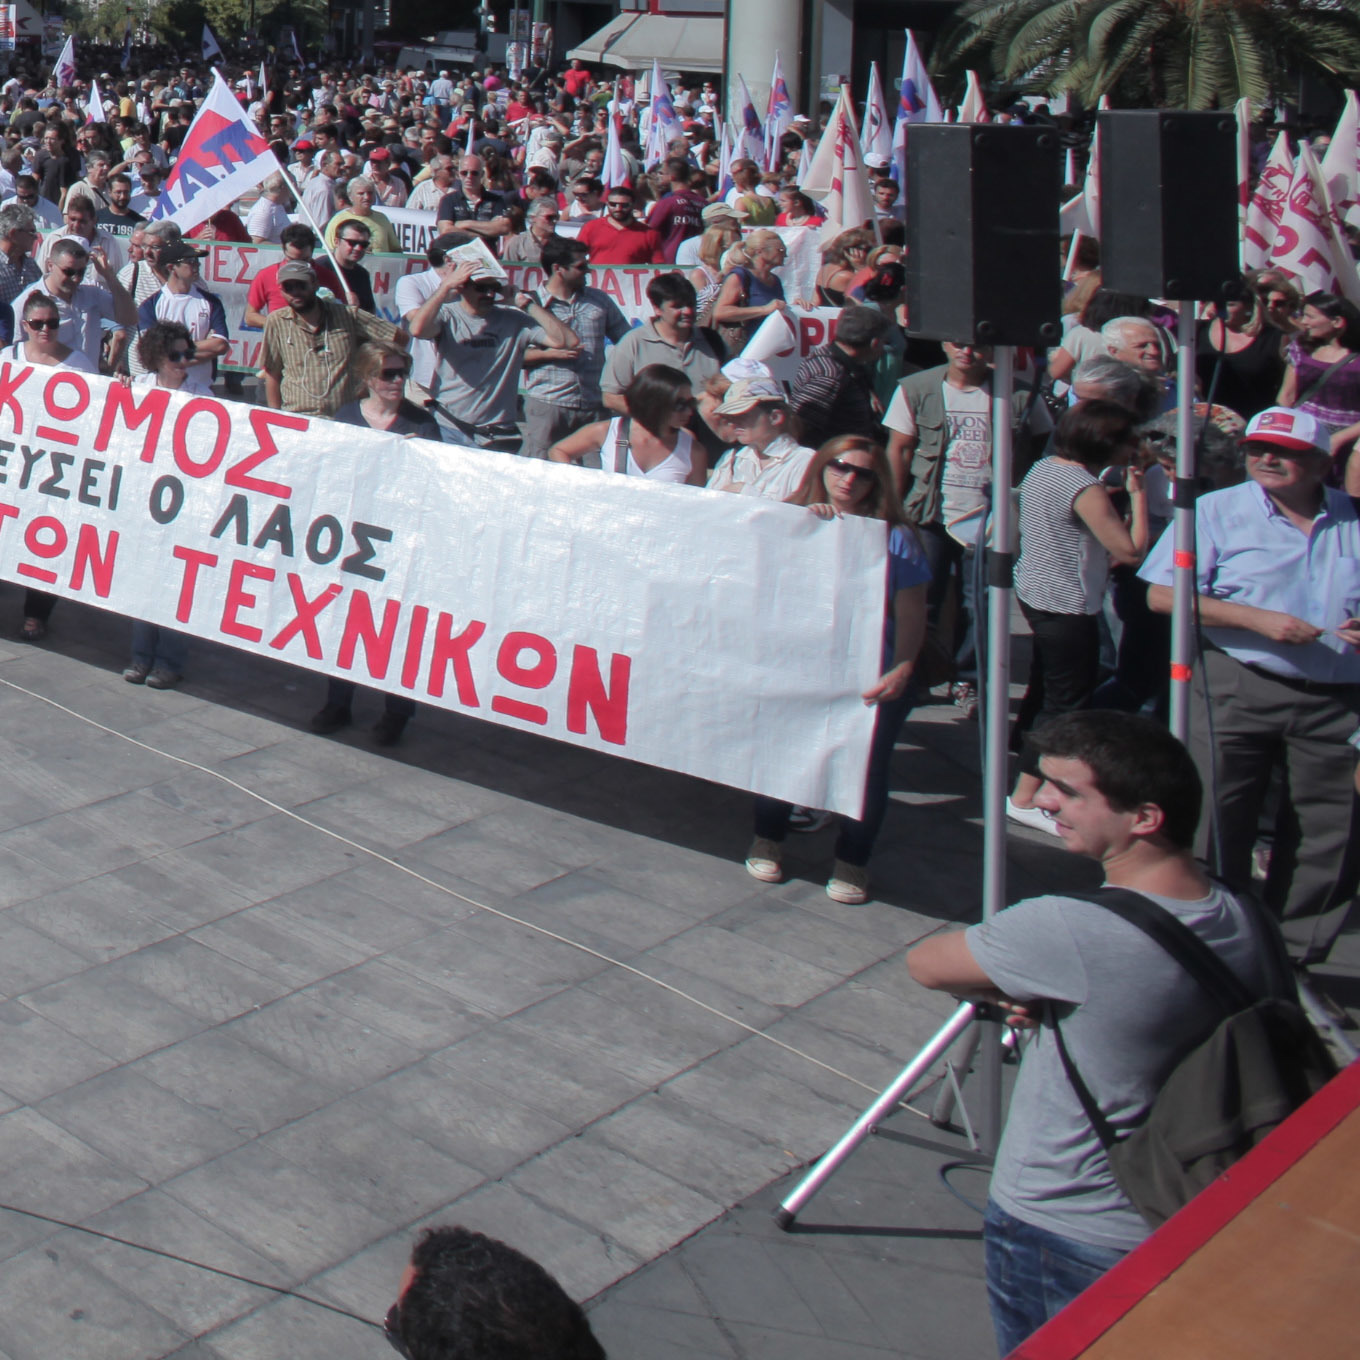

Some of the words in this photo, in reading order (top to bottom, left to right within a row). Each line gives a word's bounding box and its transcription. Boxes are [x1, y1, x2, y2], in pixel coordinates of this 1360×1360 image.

[148, 474, 185, 525] Ο
[209, 493, 394, 582] ΛΑΟΣ
[172, 544, 632, 746] ΤΕΧΝΙΚΩΝ
